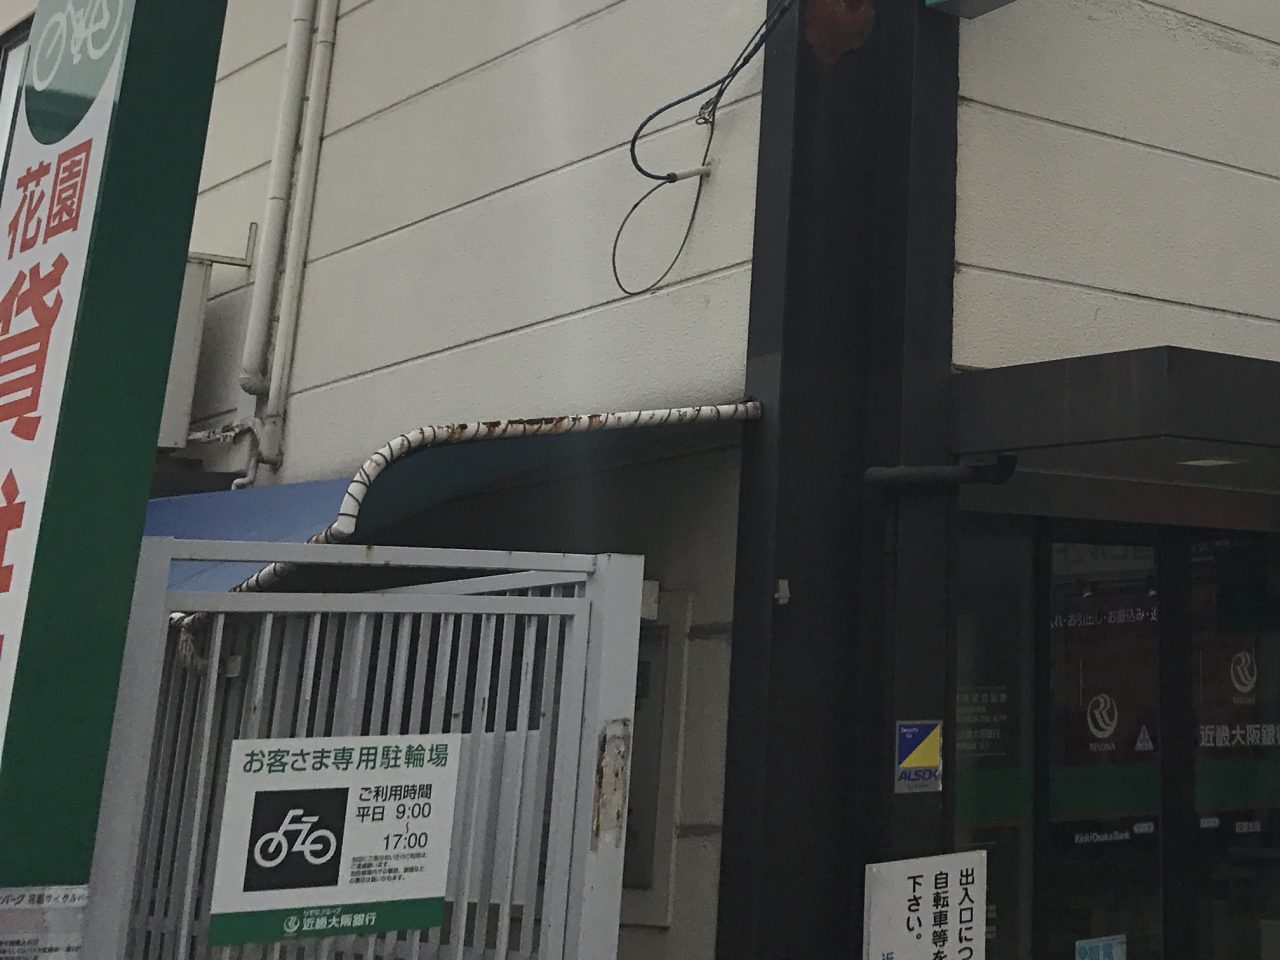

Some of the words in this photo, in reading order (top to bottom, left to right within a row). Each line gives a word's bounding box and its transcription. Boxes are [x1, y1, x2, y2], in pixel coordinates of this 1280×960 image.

[8, 138, 94, 261] 花園
[243, 743, 449, 774] お客さま専用駐輪場
[358, 784, 433, 802] ご利用時間
[355, 807, 386, 823] 平日
[396, 803, 432, 820] 9:00
[383, 833, 428, 851] 17:00
[302, 912, 377, 931] 近畿大阪銀行
[906, 874, 924, 940] 下さい。
[932, 871, 950, 960] 自転車等を
[958, 867, 975, 960] 出入口につ
